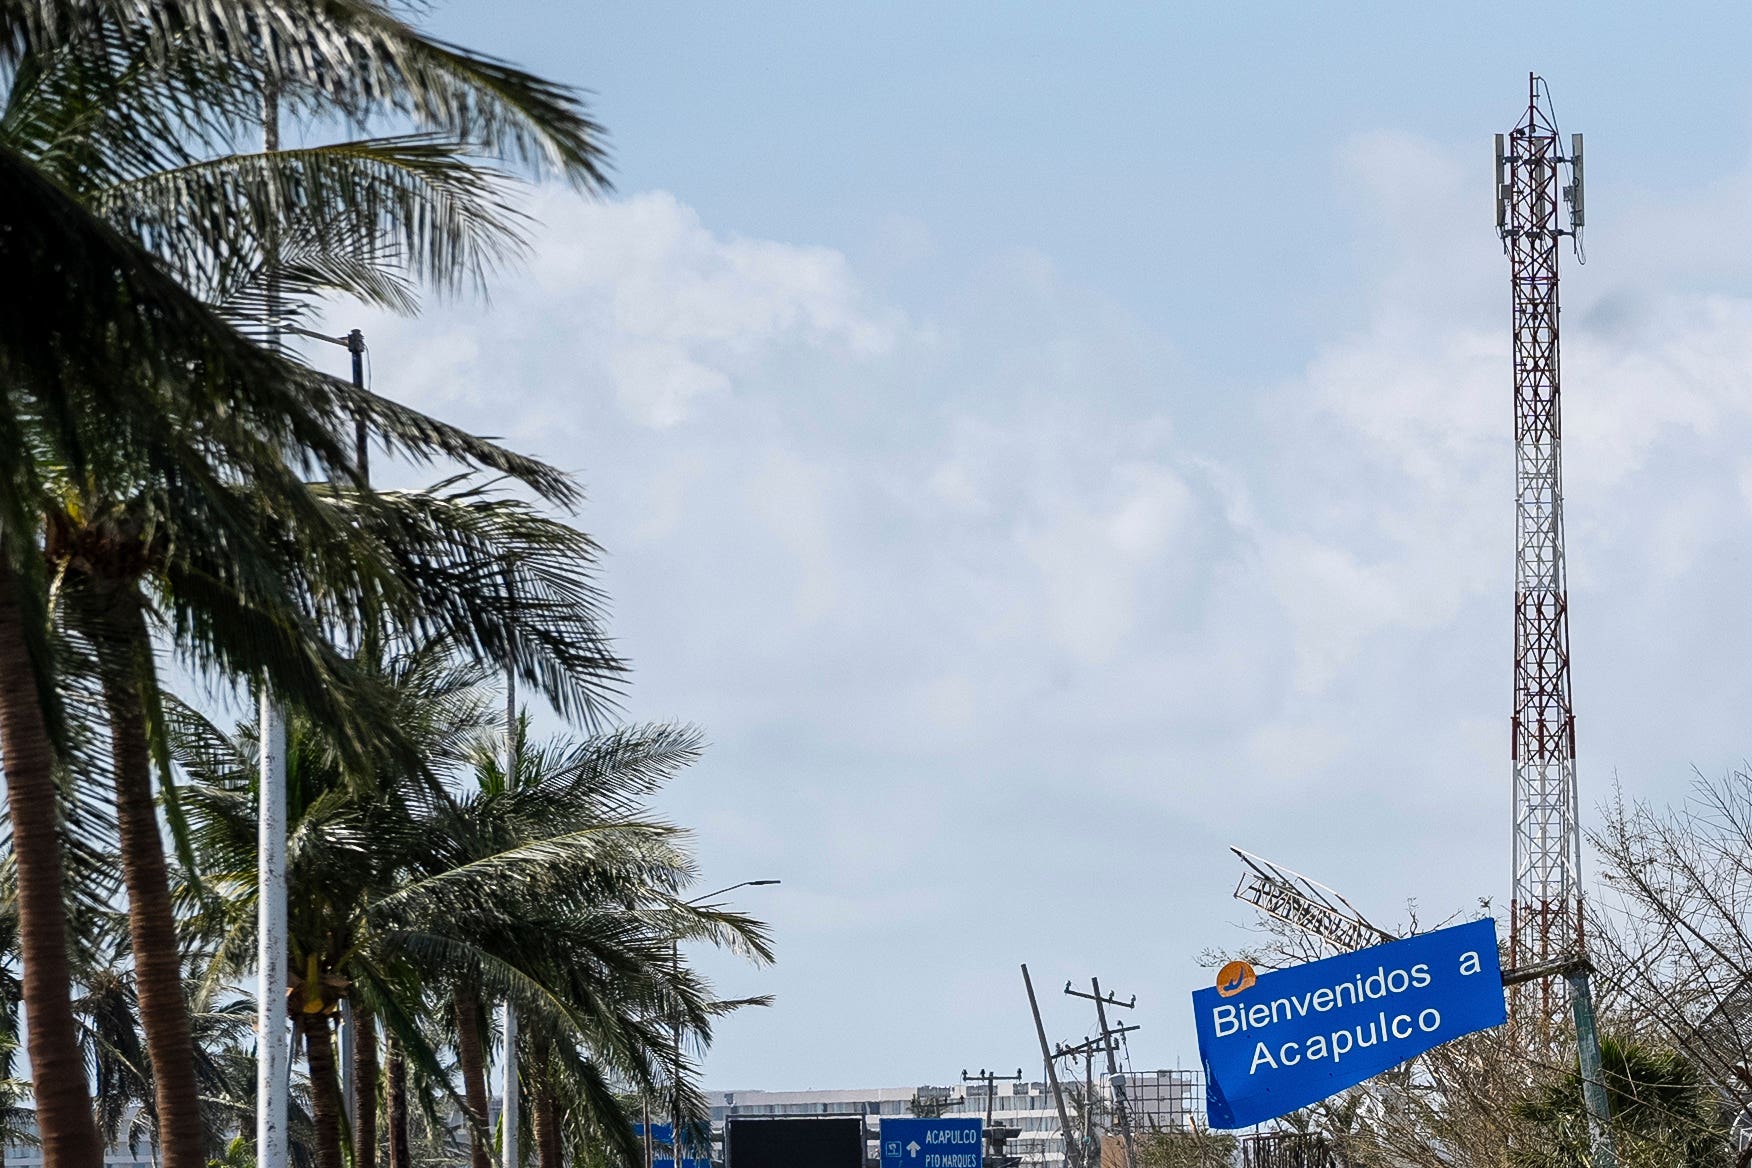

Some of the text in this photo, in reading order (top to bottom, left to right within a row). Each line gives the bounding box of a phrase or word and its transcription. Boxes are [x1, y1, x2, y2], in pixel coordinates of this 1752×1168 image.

[1212, 951, 1481, 1038] Bienvenidos a
[1249, 1008, 1441, 1075] Acapulco
[925, 1129, 977, 1145] ACAPULCO
[925, 1154, 977, 1168] PTO MARQUES
